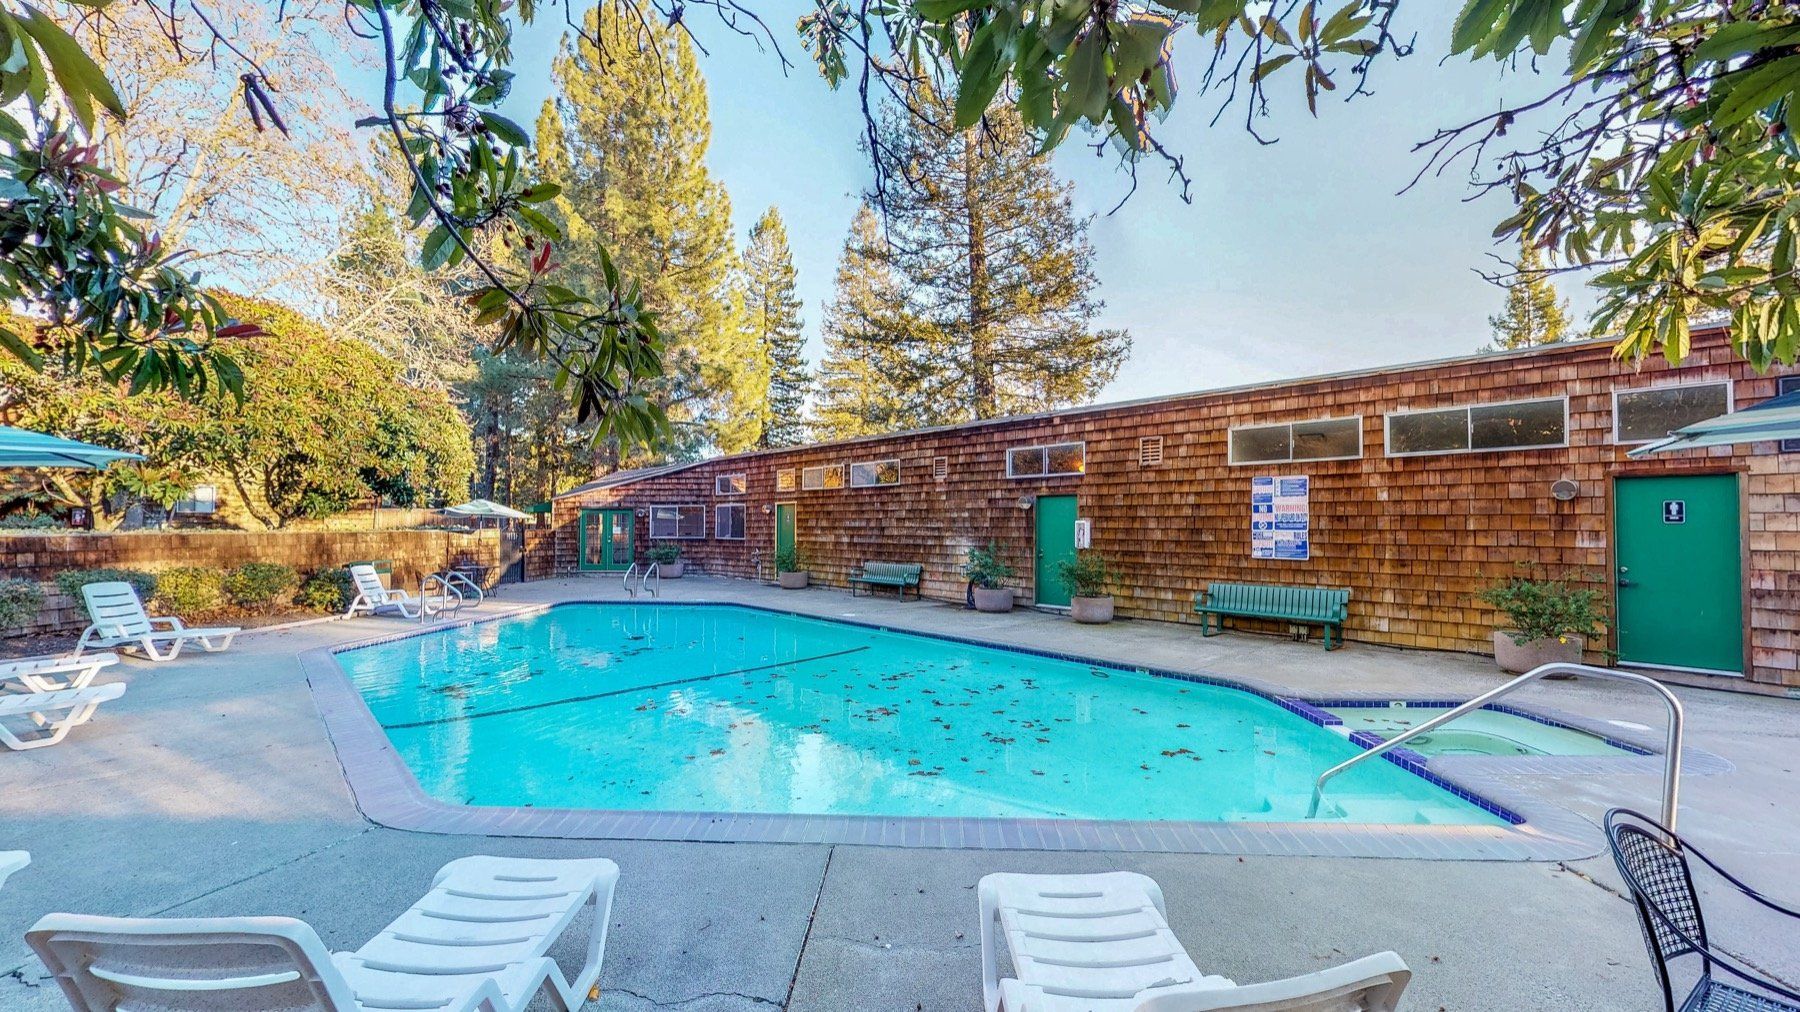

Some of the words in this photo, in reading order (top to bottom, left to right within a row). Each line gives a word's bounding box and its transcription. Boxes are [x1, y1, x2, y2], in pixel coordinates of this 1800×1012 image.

[1259, 504, 1267, 513] NO
[1275, 504, 1307, 513] WARNING!
[1294, 531, 1307, 540] RULES
